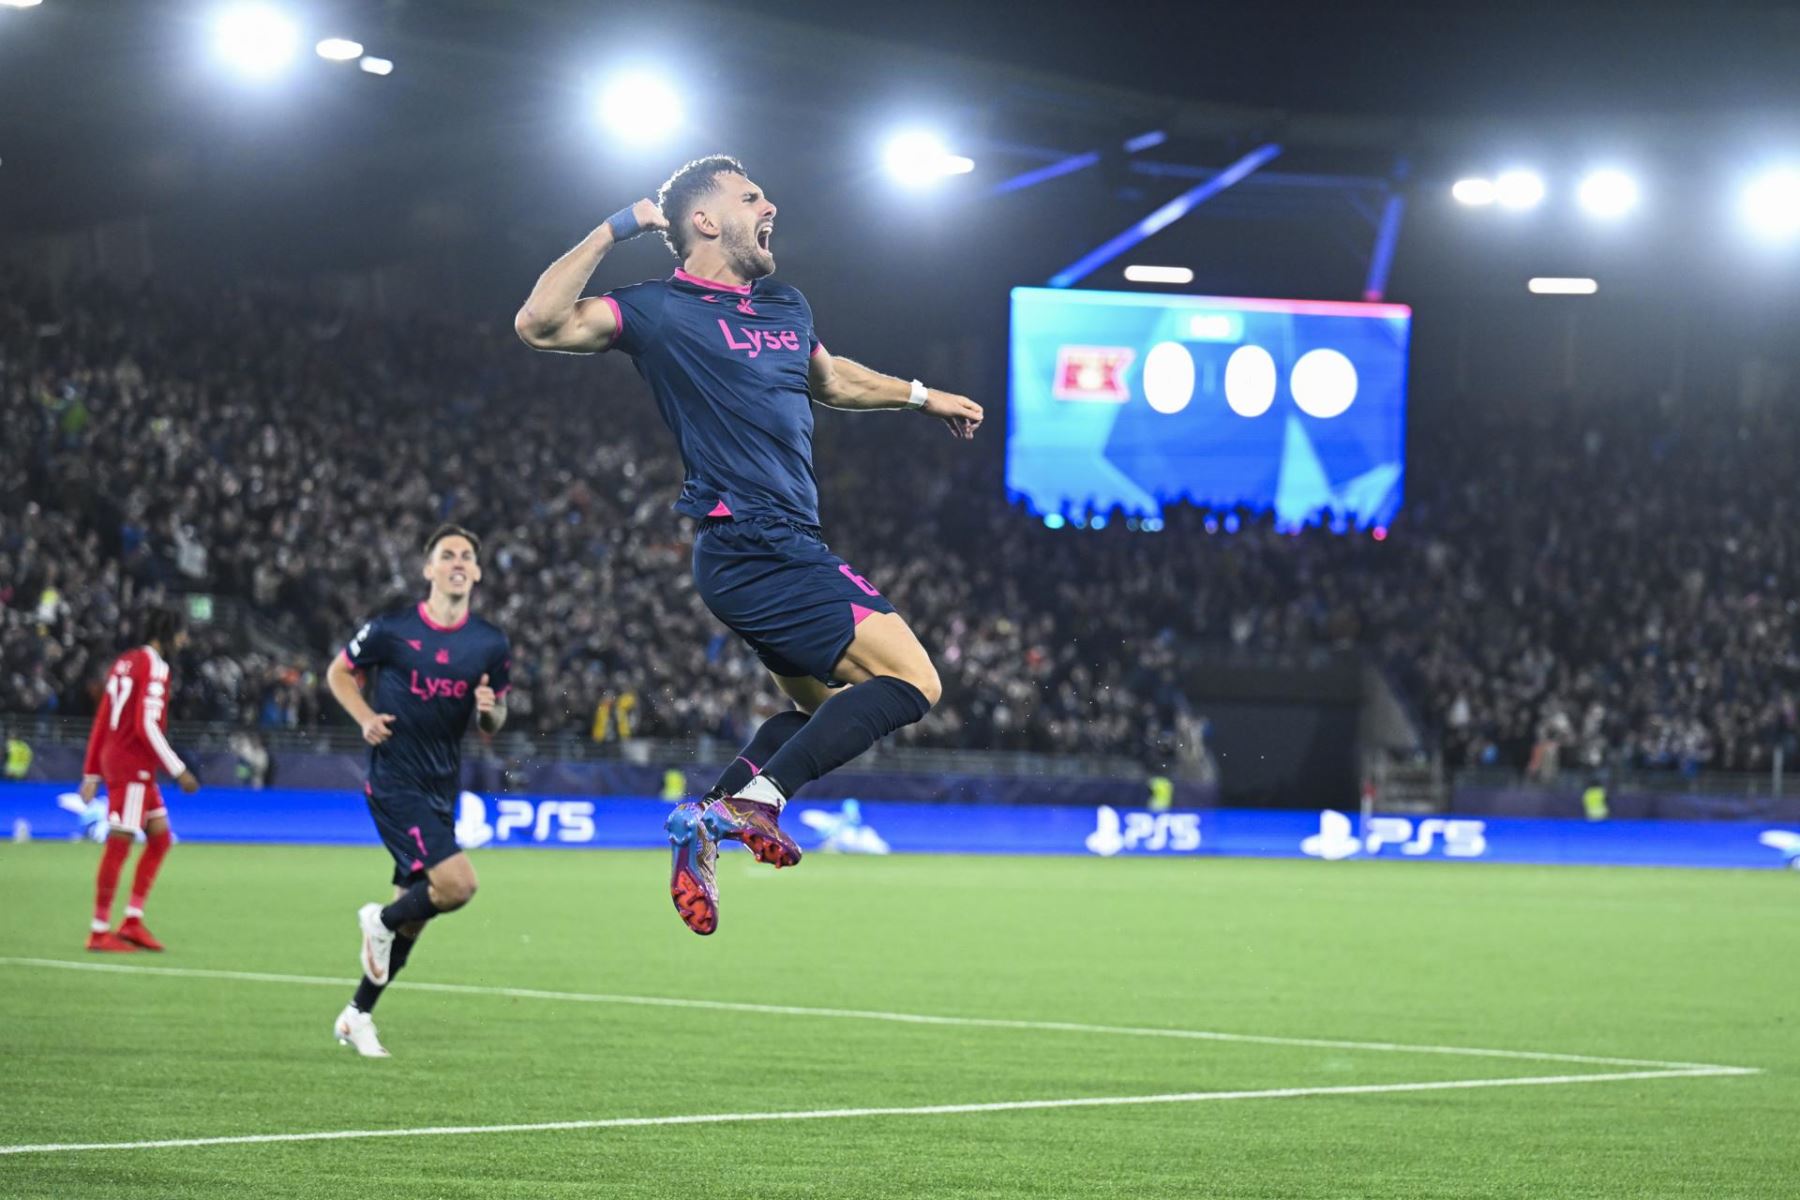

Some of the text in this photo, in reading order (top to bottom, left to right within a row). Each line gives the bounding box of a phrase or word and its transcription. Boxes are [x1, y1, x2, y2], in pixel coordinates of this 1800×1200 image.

[717, 319, 800, 358] Lyse
[838, 564, 880, 596] 6
[411, 669, 468, 700] Lyse
[496, 800, 595, 842] PS5
[1125, 812, 1200, 851] PS5
[1366, 817, 1486, 858] PS5
